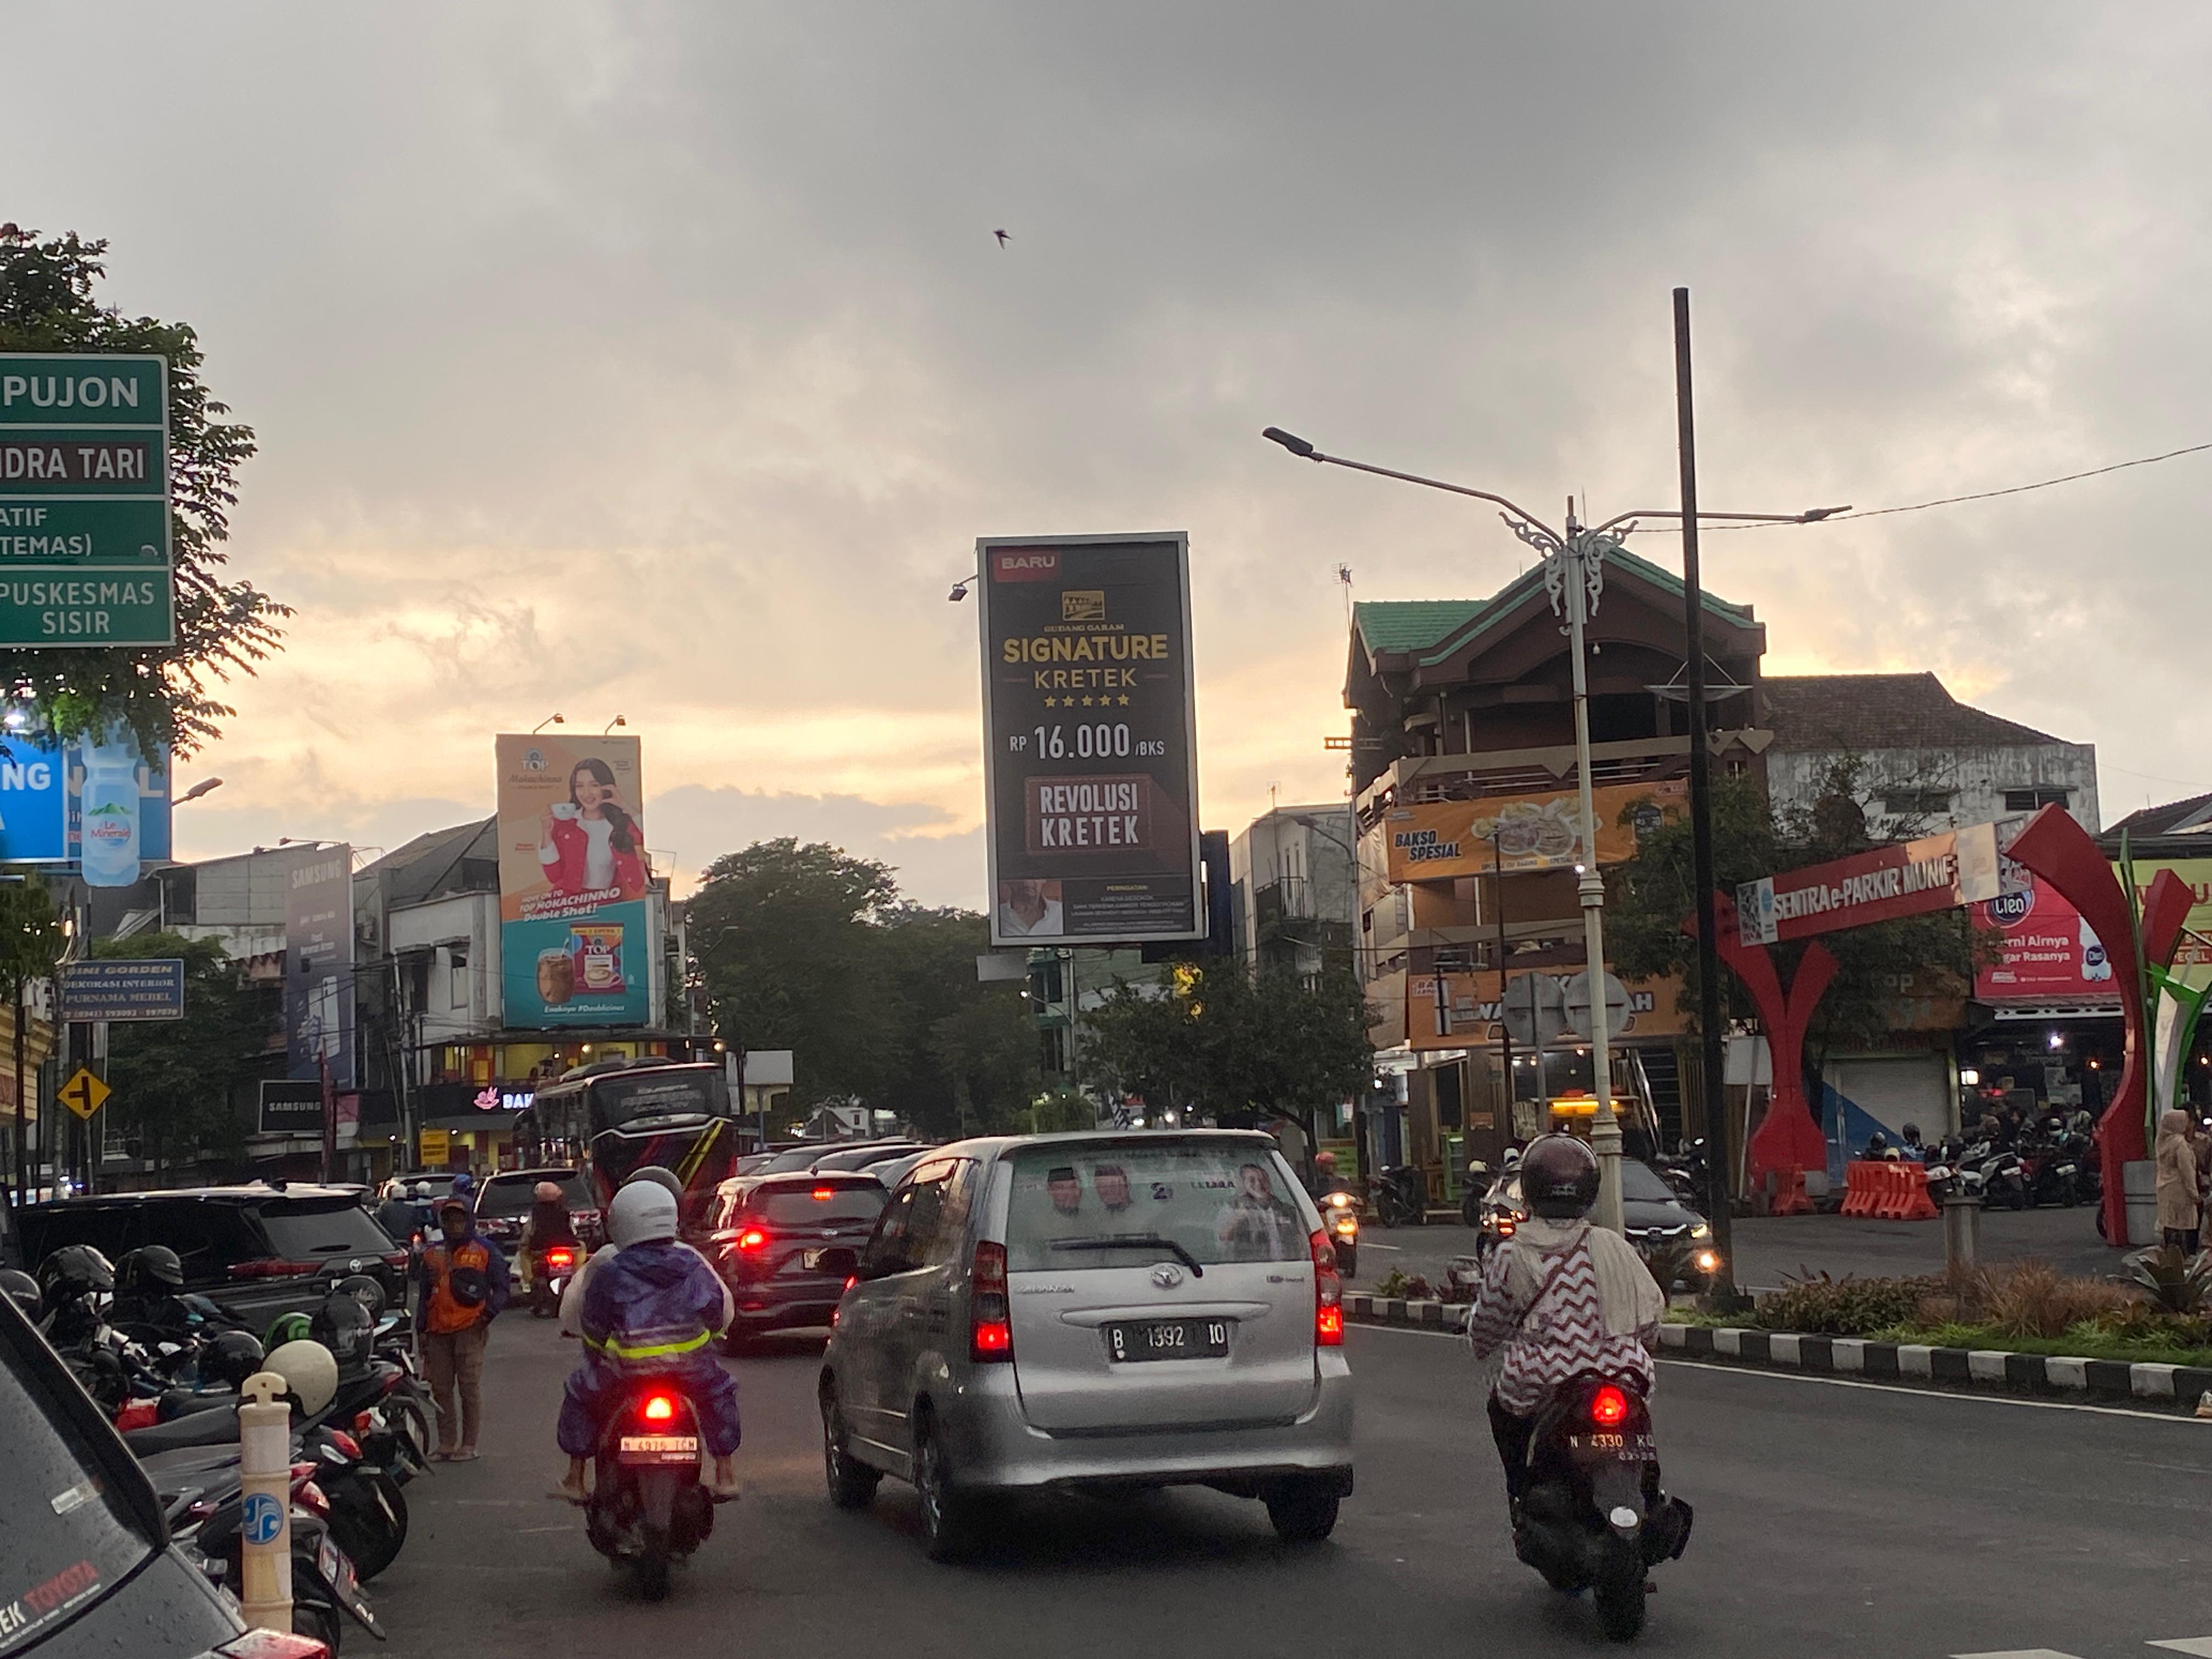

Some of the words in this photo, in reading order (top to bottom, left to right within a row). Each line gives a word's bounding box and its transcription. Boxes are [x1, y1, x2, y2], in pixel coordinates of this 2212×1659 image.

[3, 376, 138, 407] PUJON
[0, 448, 67, 478] DRA
[78, 448, 144, 478] TARI
[1001, 556, 1056, 569] BARU
[42, 611, 110, 634] SISIR
[1003, 634, 1169, 663] SIGNATURE
[1035, 668, 1137, 689] KRETEK
[1010, 736, 1027, 752] RP
[1034, 723, 1130, 759] 16.000
[1135, 741, 1165, 756] /BKS
[522, 760, 549, 771] TOP
[2, 763, 51, 791] NG
[1040, 783, 1137, 814] REVOLUSI
[91, 829, 131, 841] Minerale
[104, 821, 116, 830] Le
[1041, 815, 1138, 847] KRETEK
[1395, 830, 1436, 847] BAKSO
[1409, 843, 1462, 861] SPESIAL
[292, 859, 342, 889] SAMSUNG
[537, 887, 620, 910] MOKACHINNO
[554, 889, 563, 898] TO
[1774, 884, 1831, 921] SENTRA
[1831, 868, 1901, 909] e-PARKIR
[523, 911, 560, 922] Double
[562, 902, 597, 917] Shot!
[585, 945, 610, 954] TOP
[2028, 935, 2069, 949] Airnya
[2022, 952, 2070, 963] Rasanya
[122, 979, 174, 988] INTERIOR
[66, 994, 126, 1003] PURNAMA
[129, 992, 172, 1002] MEBEL
[269, 1102, 321, 1112] SAMSUNG
[1114, 1330, 1124, 1349] B
[1147, 1329, 1184, 1347] 1392
[1570, 1435, 1579, 1448] N
[24, 1559, 99, 1615] TOYOTA
[0, 1601, 26, 1638] EK
